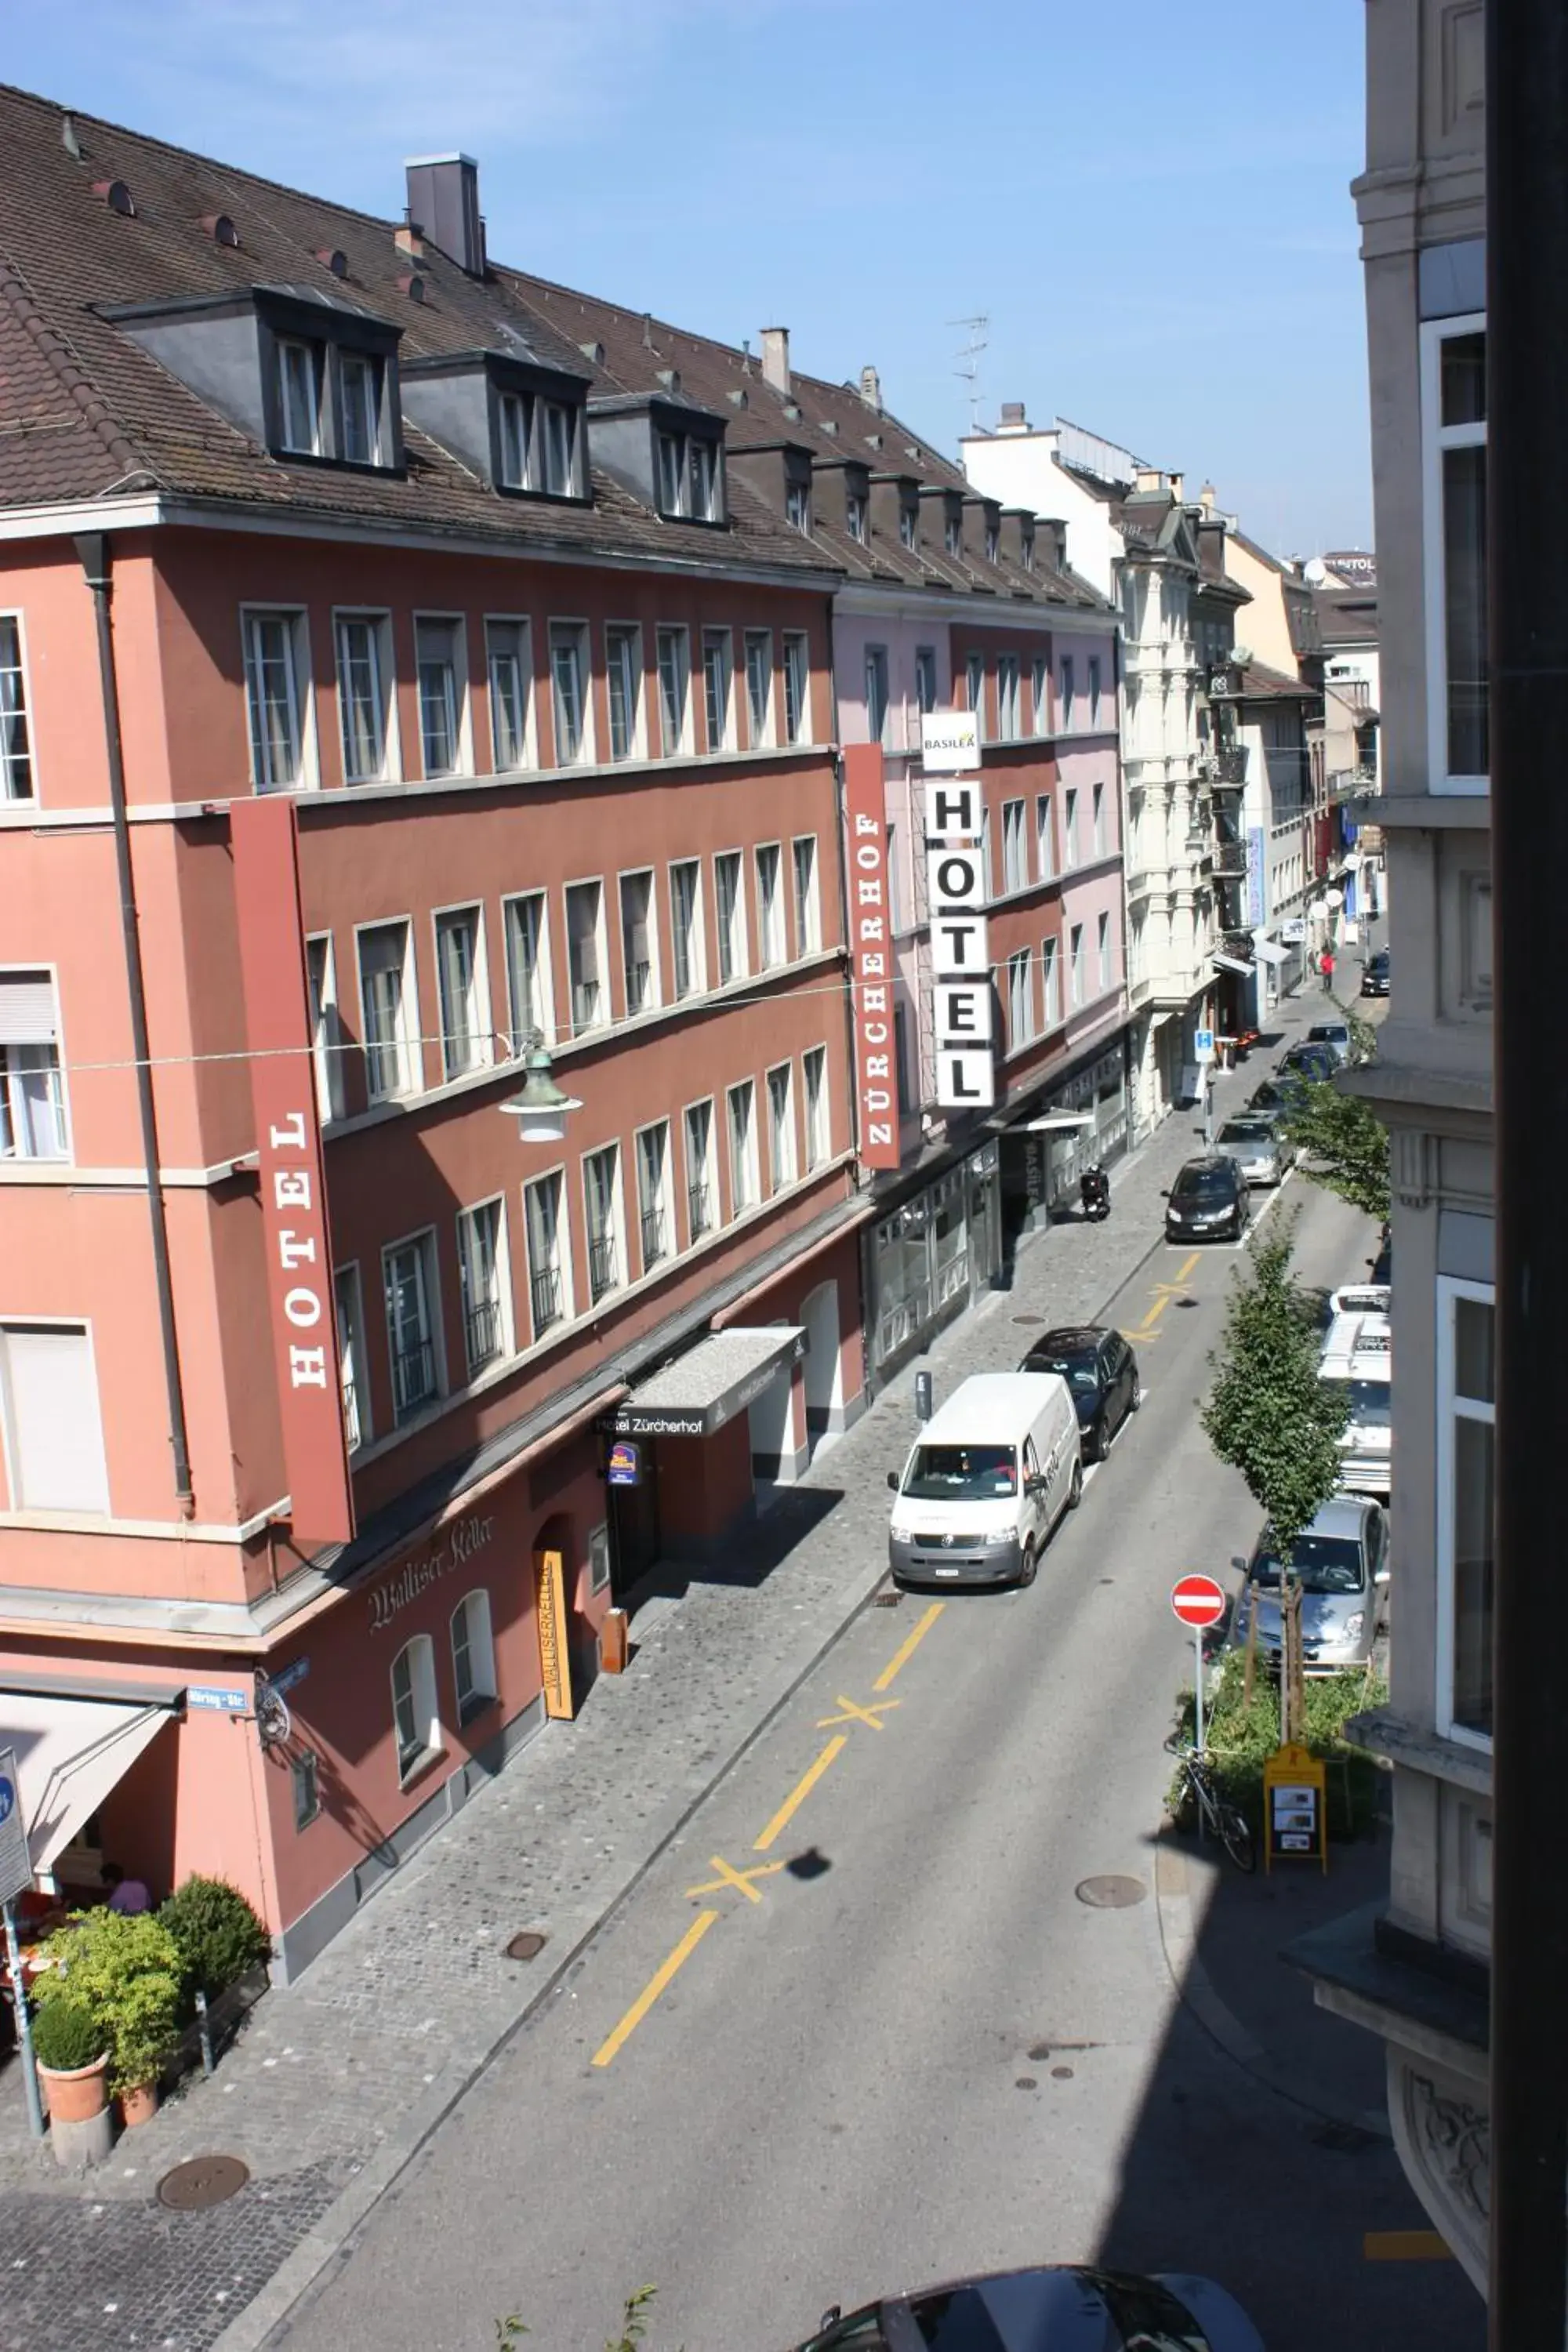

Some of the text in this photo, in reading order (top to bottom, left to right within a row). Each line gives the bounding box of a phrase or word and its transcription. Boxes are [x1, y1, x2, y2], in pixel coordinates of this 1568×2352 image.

[855, 814, 891, 1145] ZÜRCHERHOF
[935, 790, 980, 1098] HOTEL
[270, 1112, 327, 1388] HOTEL
[633, 1417, 702, 1434] Zürcherhof
[368, 1515, 495, 1636] Walliser Keller
